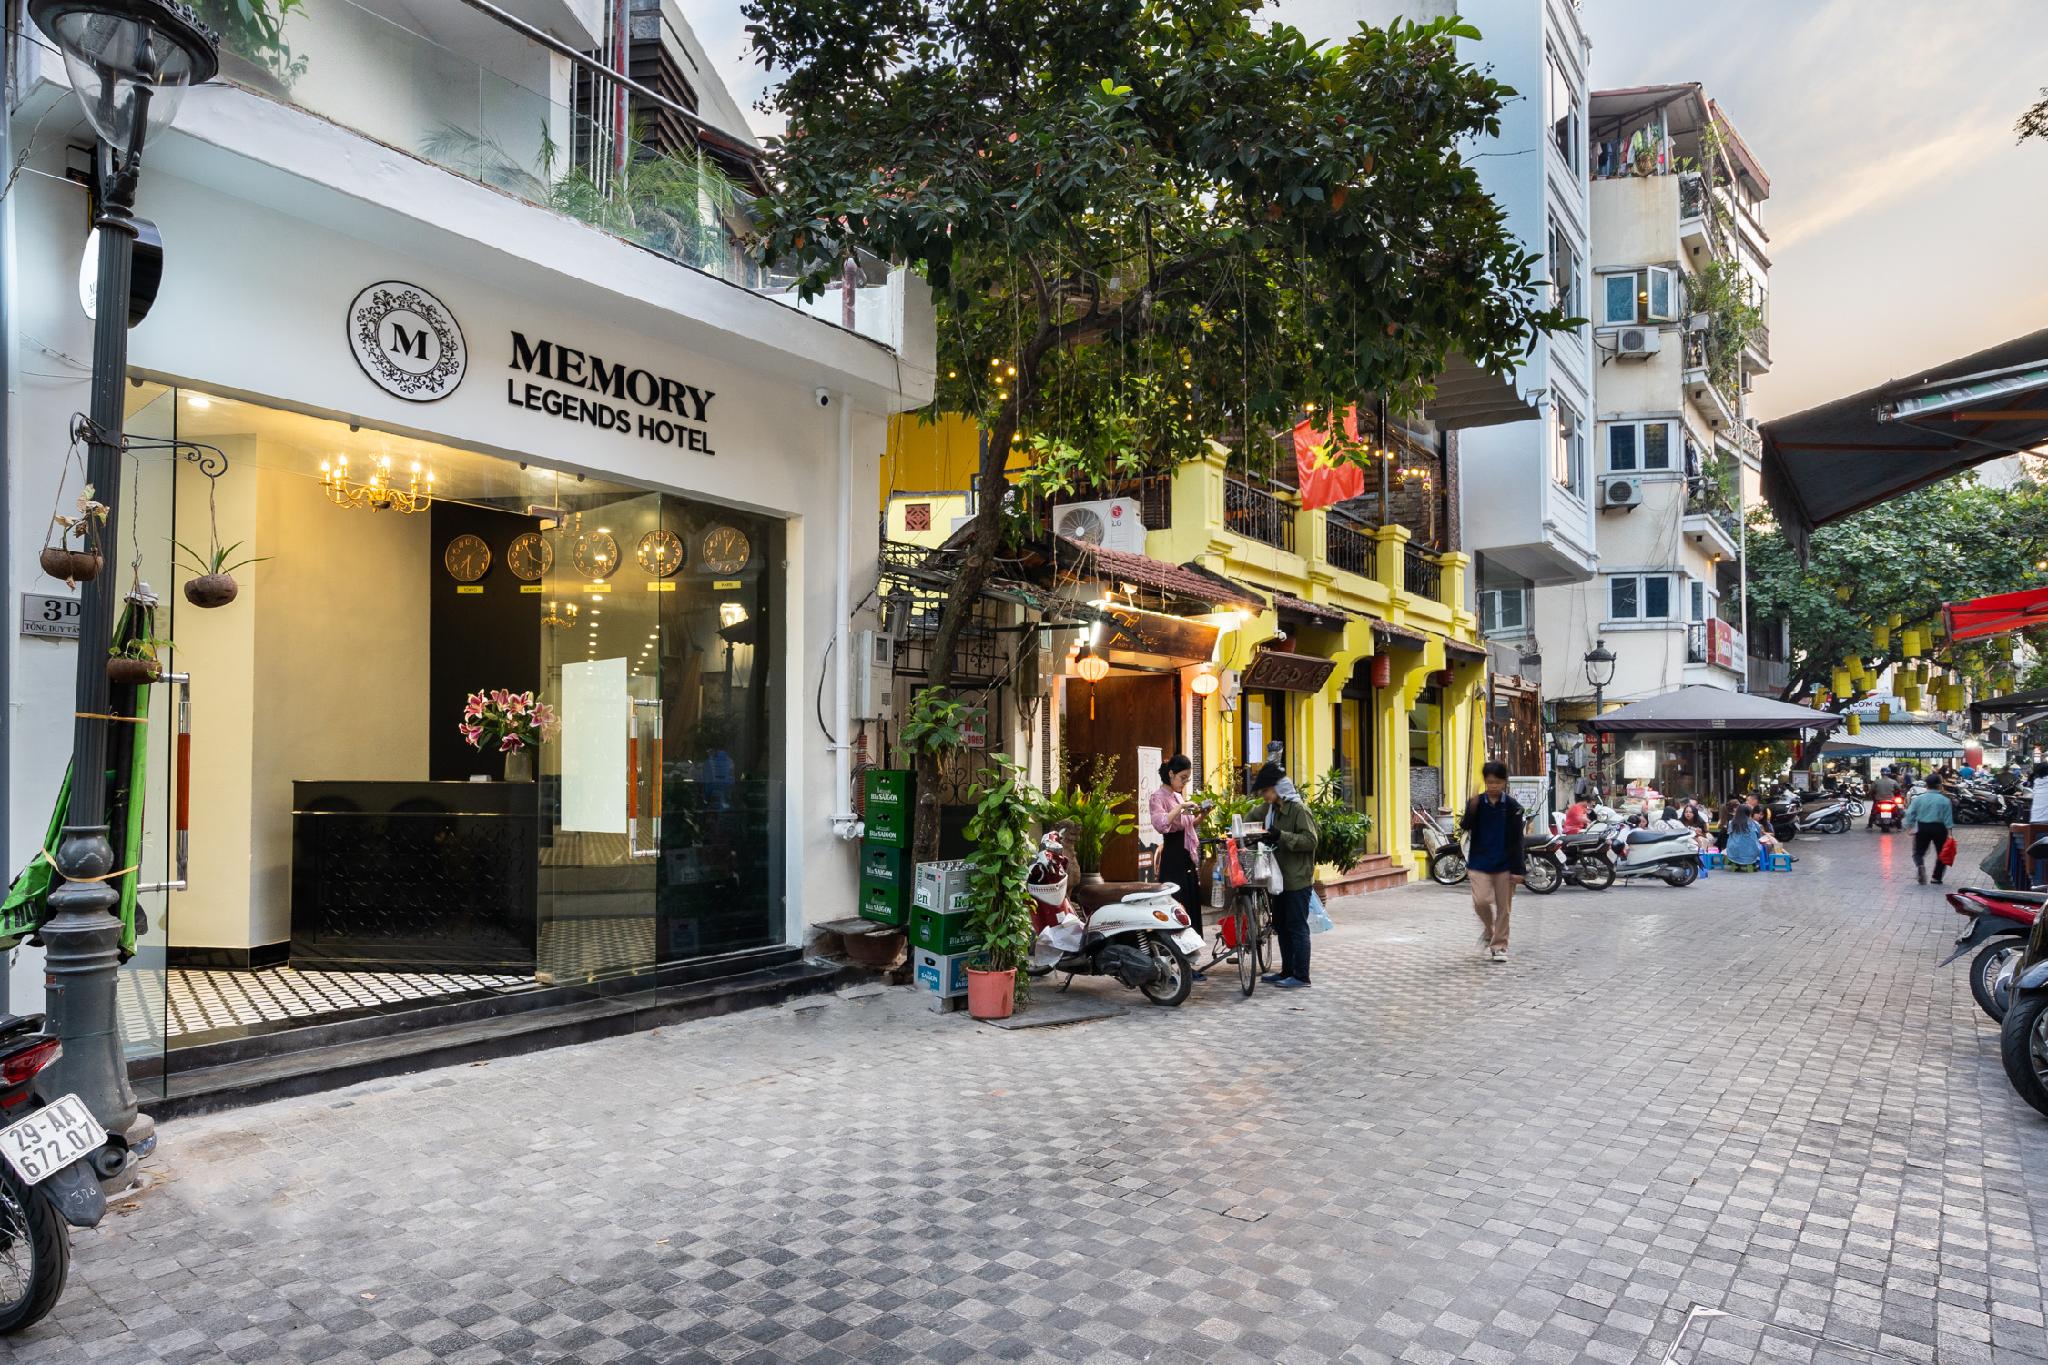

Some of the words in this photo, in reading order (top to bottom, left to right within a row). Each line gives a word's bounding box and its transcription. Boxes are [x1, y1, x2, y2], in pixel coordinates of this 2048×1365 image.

[390, 322, 430, 361] M
[508, 330, 716, 423] MEMORY
[507, 378, 632, 434] LEGENDS
[638, 413, 716, 456] HOTEL
[10, 1105, 77, 1151] 29-AA
[20, 1121, 95, 1178] 672.07
